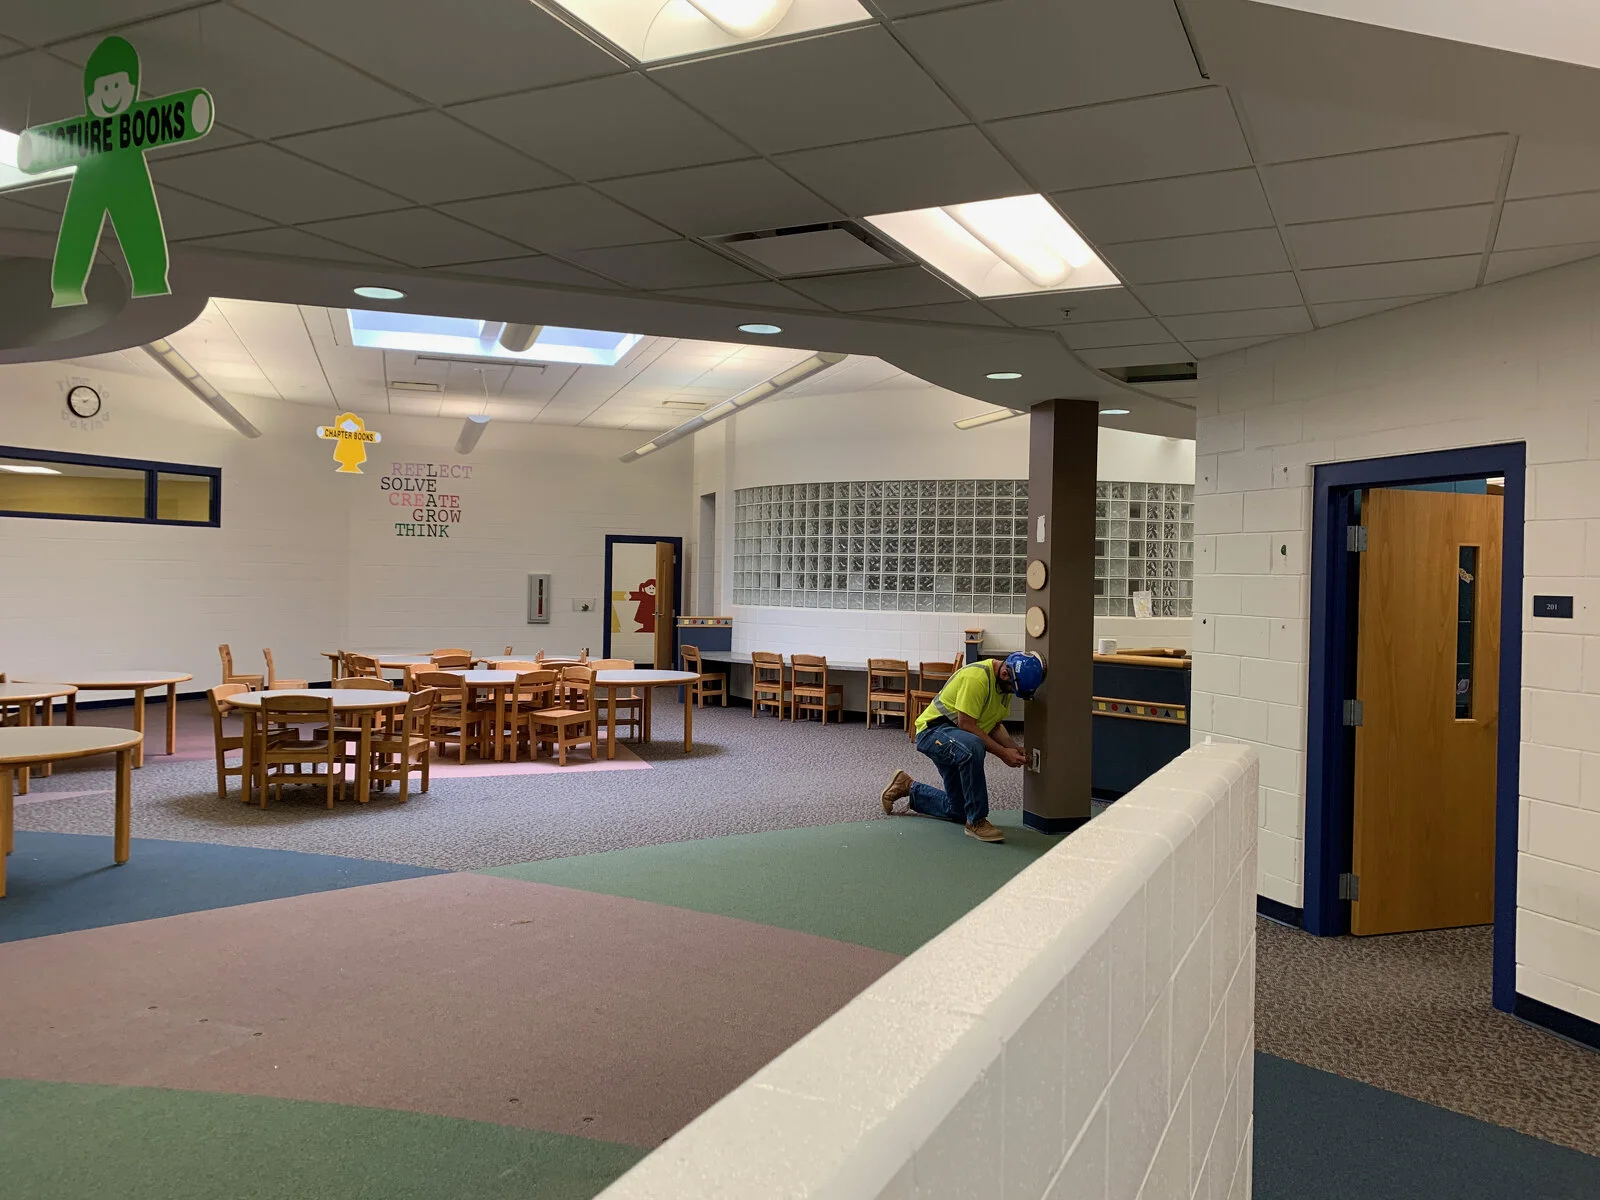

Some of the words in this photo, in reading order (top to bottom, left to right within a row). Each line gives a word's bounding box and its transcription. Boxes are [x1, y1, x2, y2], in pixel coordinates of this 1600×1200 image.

[120, 101, 185, 148] BOOKS
[325, 429, 352, 439] CHAPTER
[354, 432, 373, 441] BOOKS
[391, 462, 473, 479] REFLECT
[380, 476, 437, 492] SOLVE
[388, 492, 460, 508] CREATE
[412, 508, 462, 523] GROW
[395, 523, 450, 538] THINK
